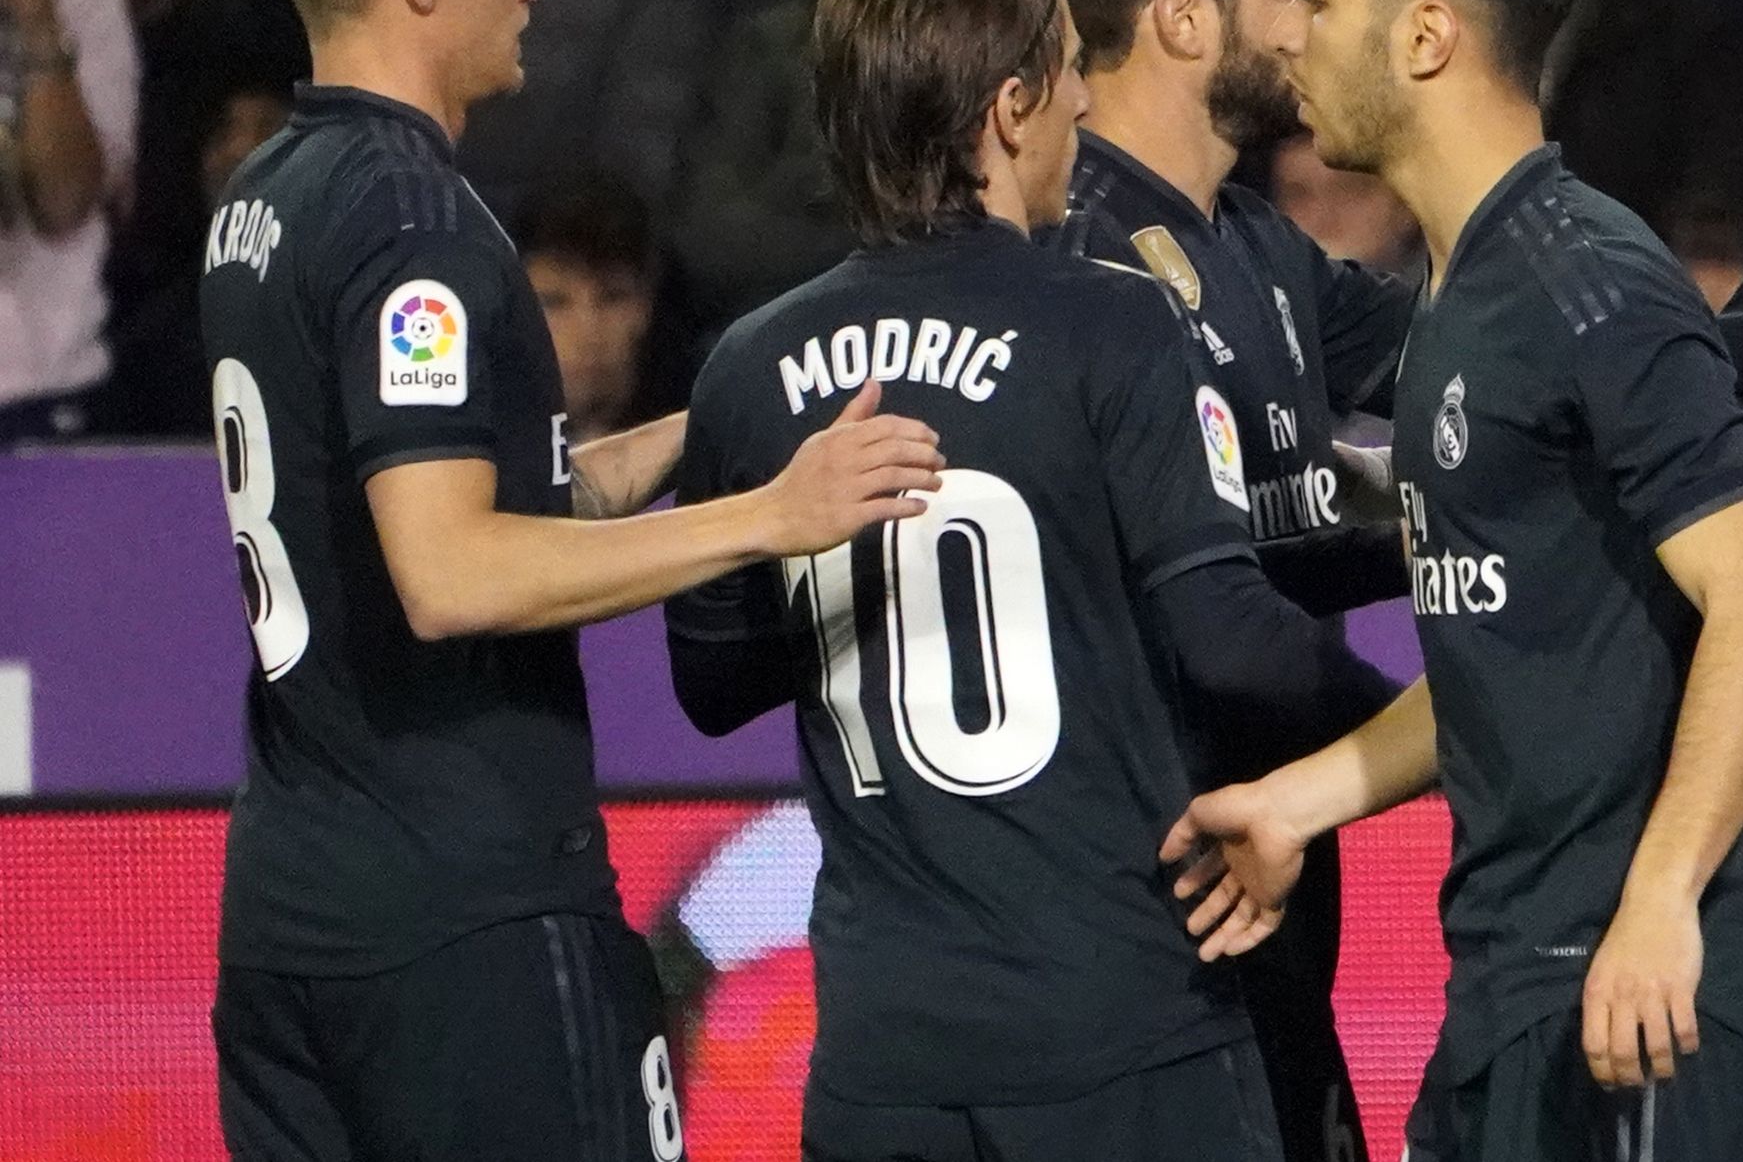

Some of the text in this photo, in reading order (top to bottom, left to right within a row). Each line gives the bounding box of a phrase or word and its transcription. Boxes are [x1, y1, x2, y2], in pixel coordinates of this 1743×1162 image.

[390, 367, 457, 389] LaLiga
[778, 317, 1019, 416] MODRIĆ
[212, 357, 310, 683] 8
[782, 468, 1061, 797] 10
[640, 1034, 683, 1162] 8
